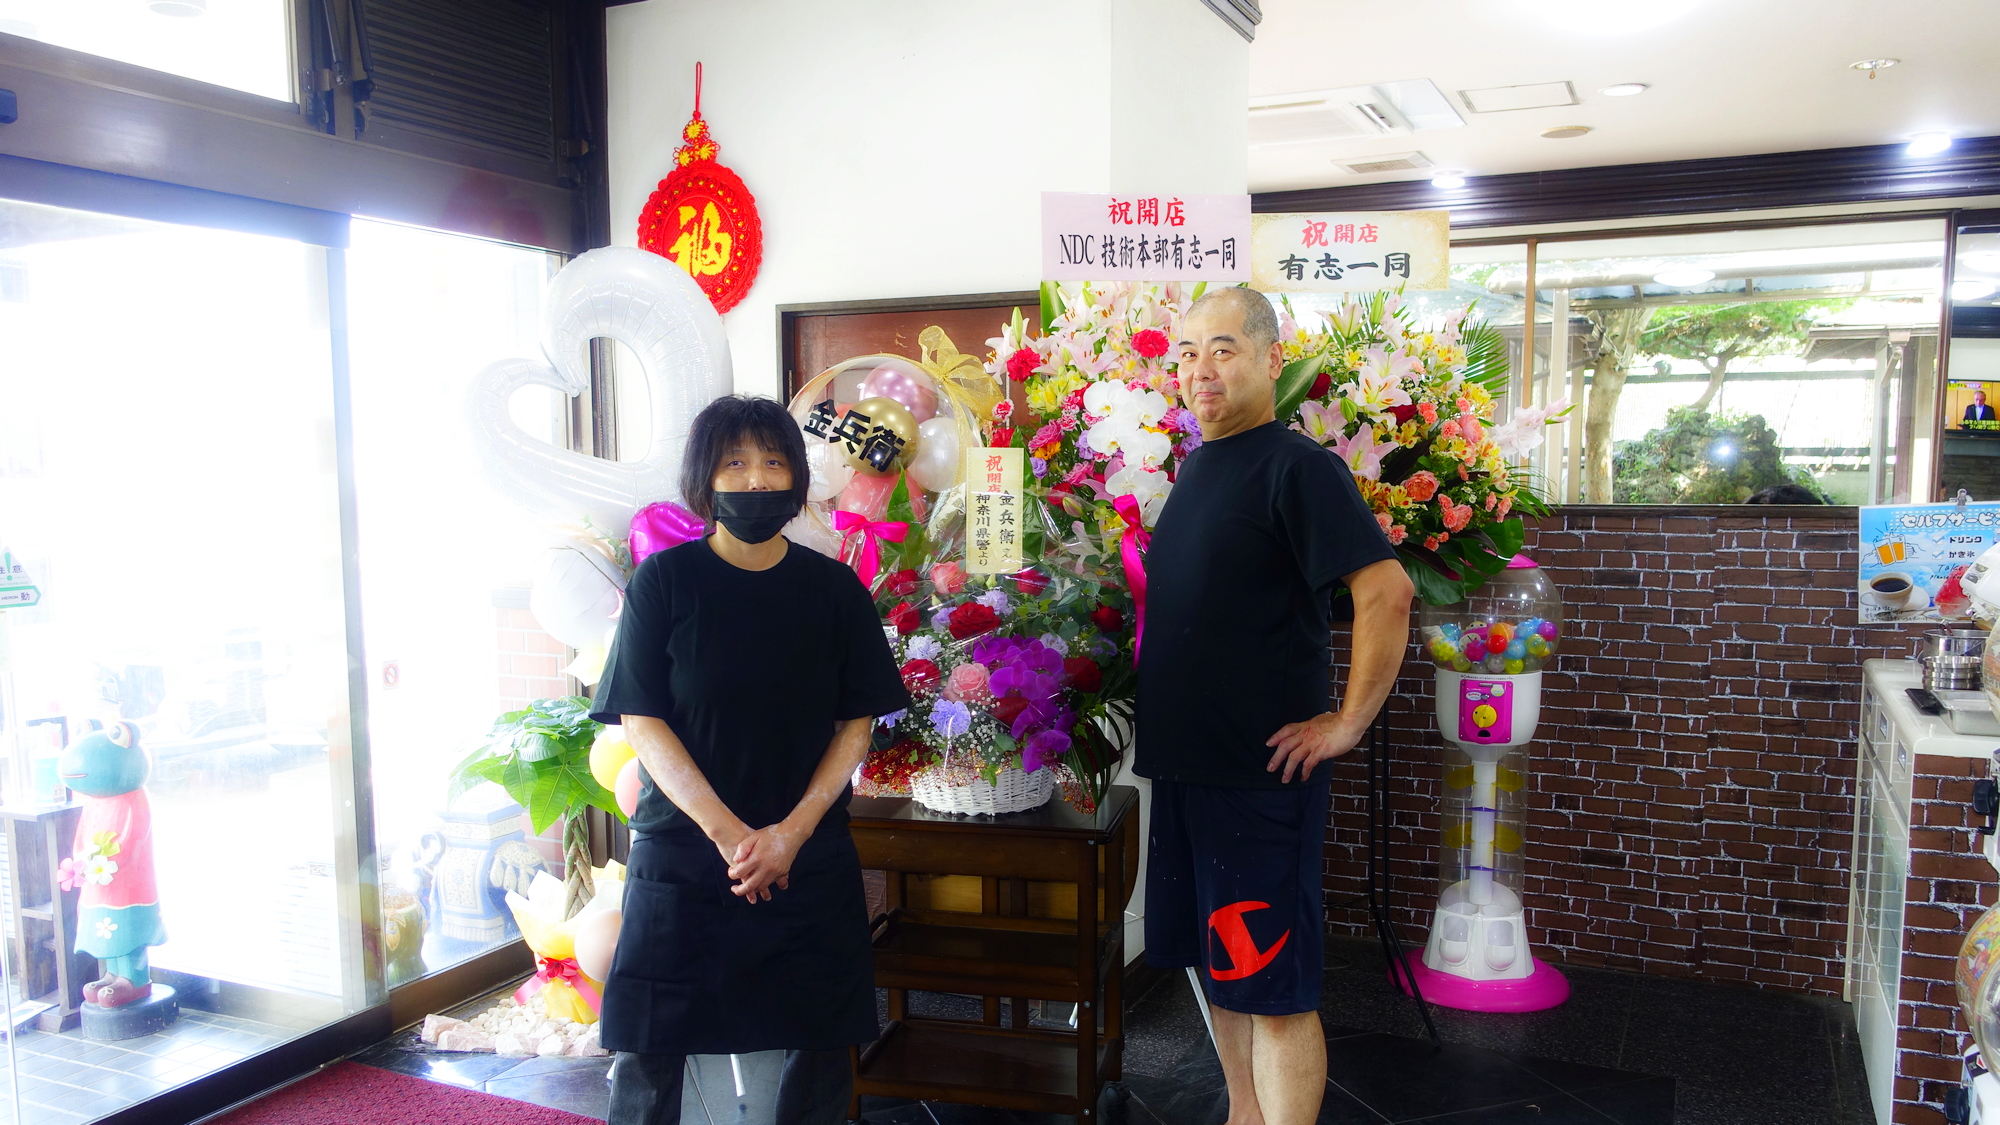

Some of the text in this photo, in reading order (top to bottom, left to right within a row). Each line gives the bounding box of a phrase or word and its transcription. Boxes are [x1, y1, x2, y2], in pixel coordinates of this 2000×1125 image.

[1108, 197, 1186, 227] 祝開店
[1302, 219, 1379, 248] 祝開店
[1060, 233, 1236, 270] NDC 技術本部有志一同
[1278, 252, 1411, 281] 有志一同
[803, 399, 905, 472] 金兵衛
[986, 455, 1004, 493] 祝開店
[976, 493, 991, 566] 神奈川県警より
[1949, 536, 1982, 544] ドリンク
